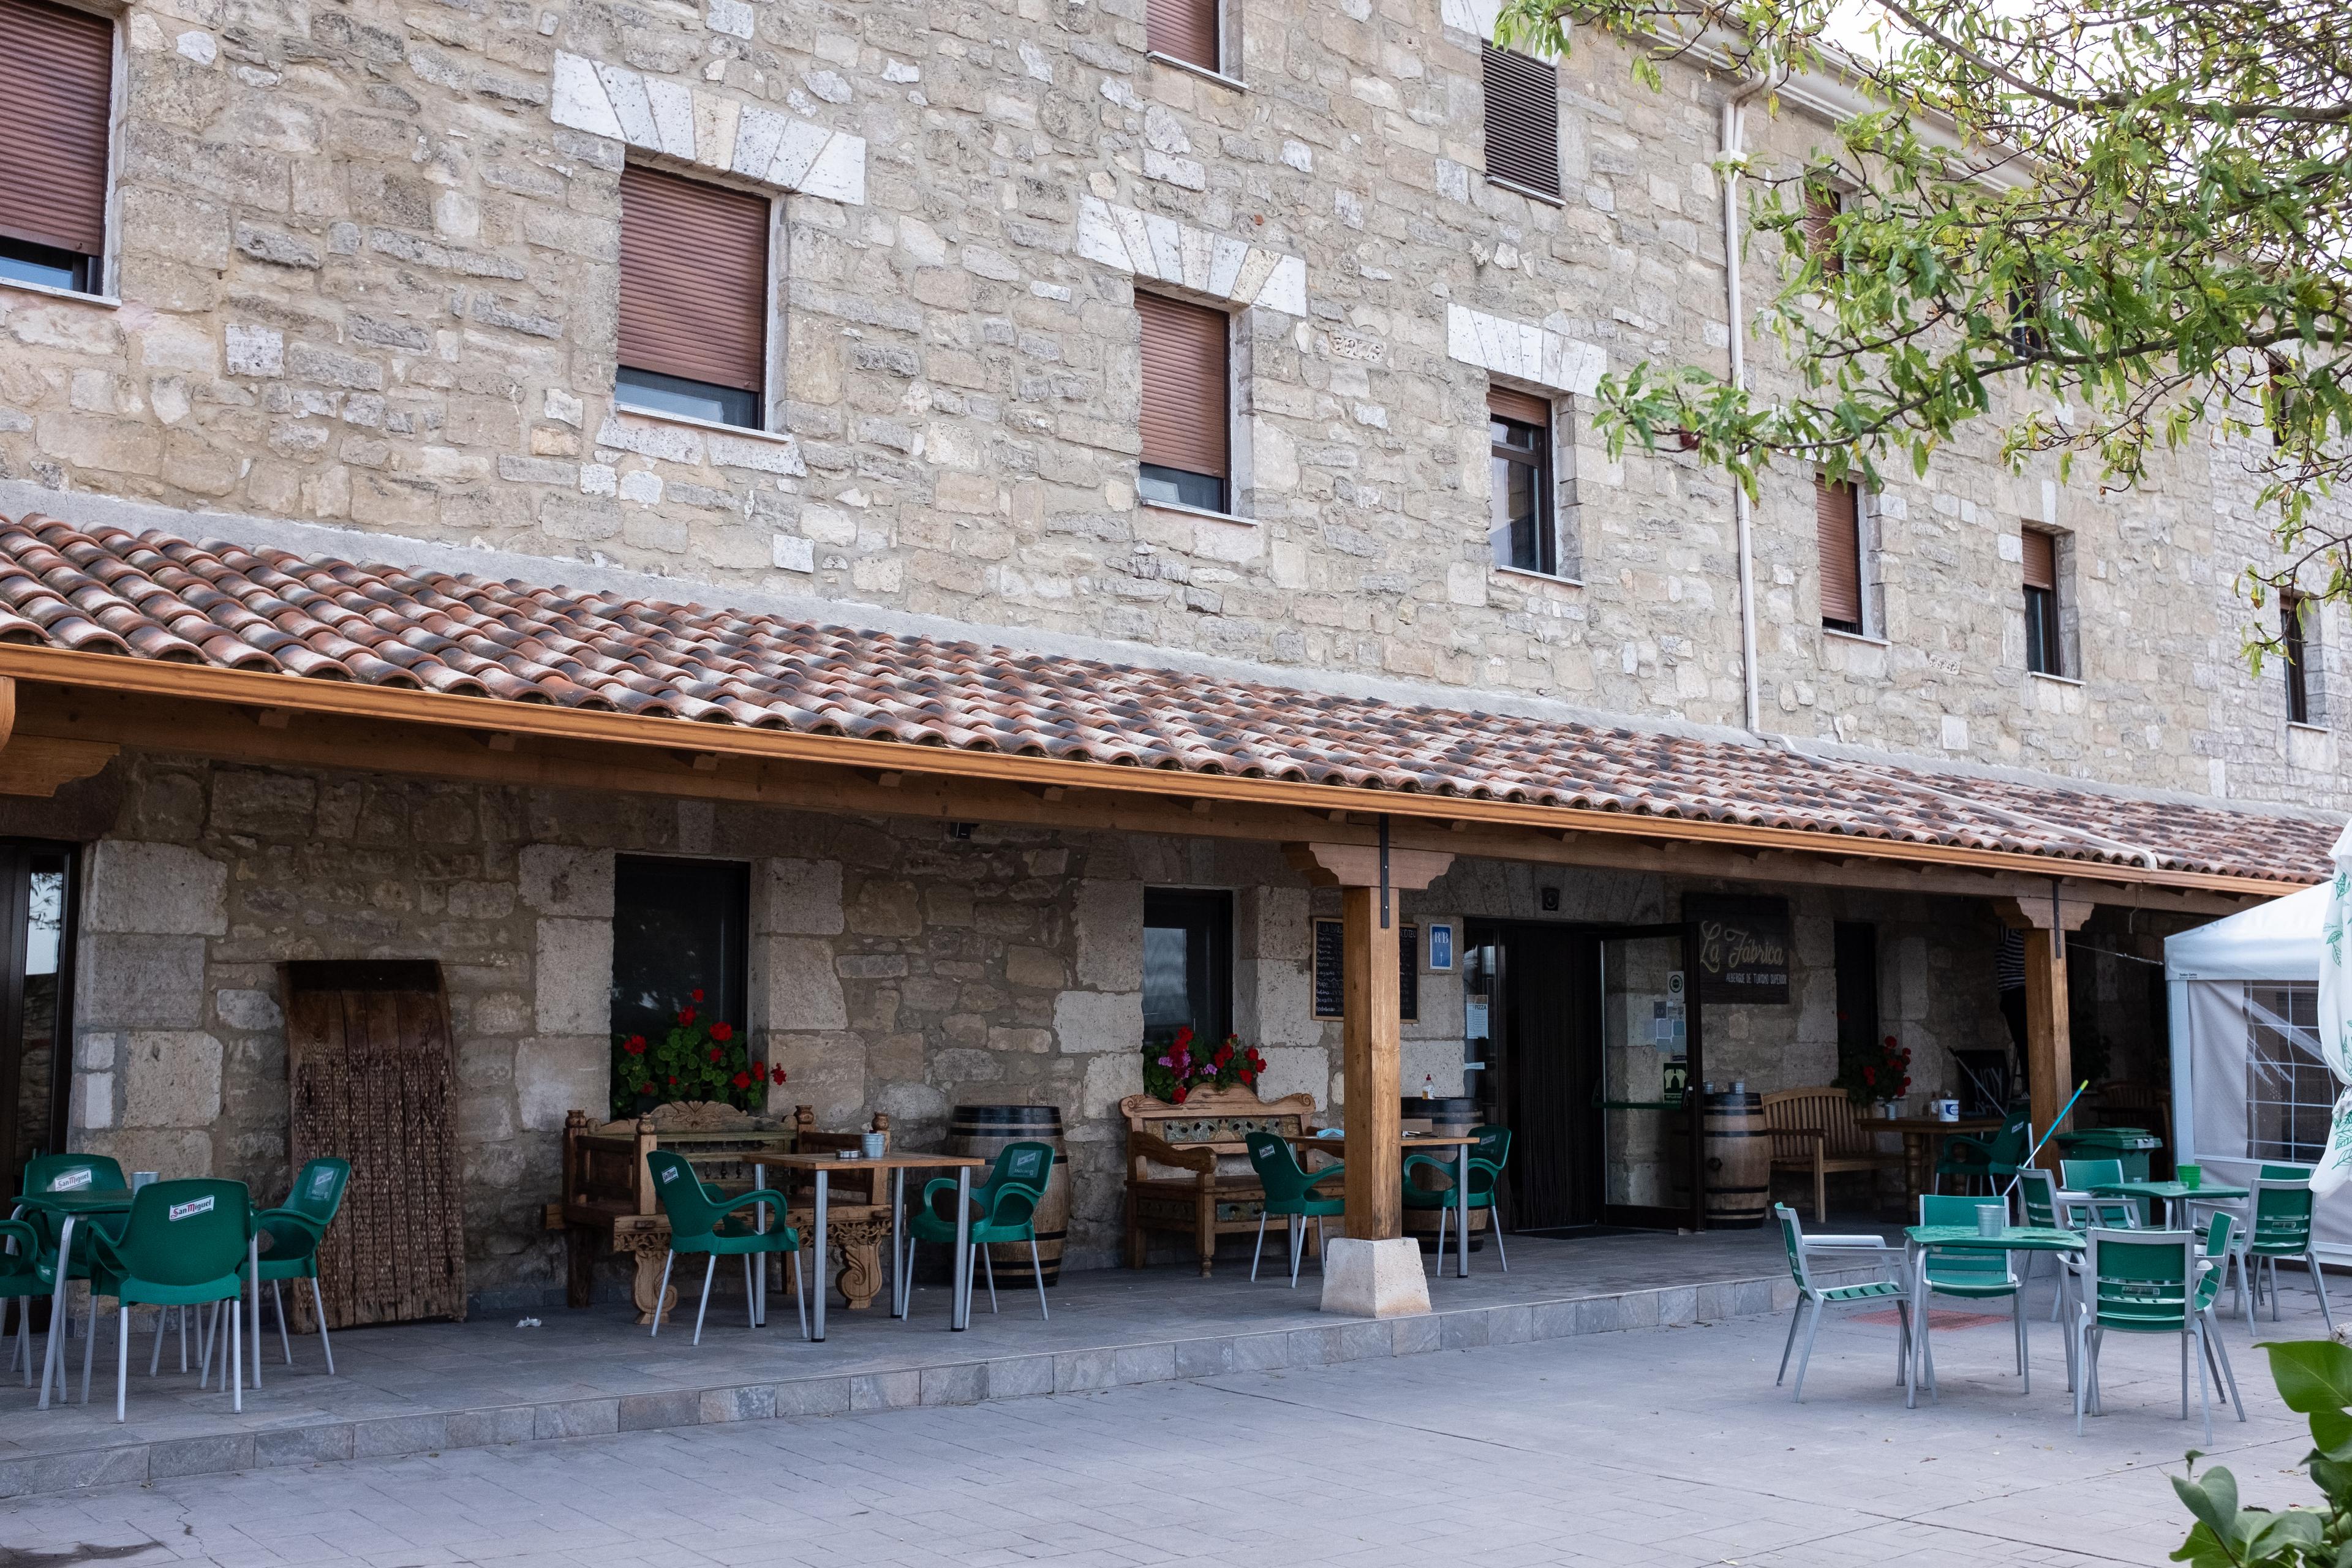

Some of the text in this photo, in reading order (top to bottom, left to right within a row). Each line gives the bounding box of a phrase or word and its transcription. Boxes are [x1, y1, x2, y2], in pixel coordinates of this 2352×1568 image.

[1434, 932, 1449, 943] RB
[1700, 921, 1721, 973] La
[1746, 973, 1752, 984] DE
